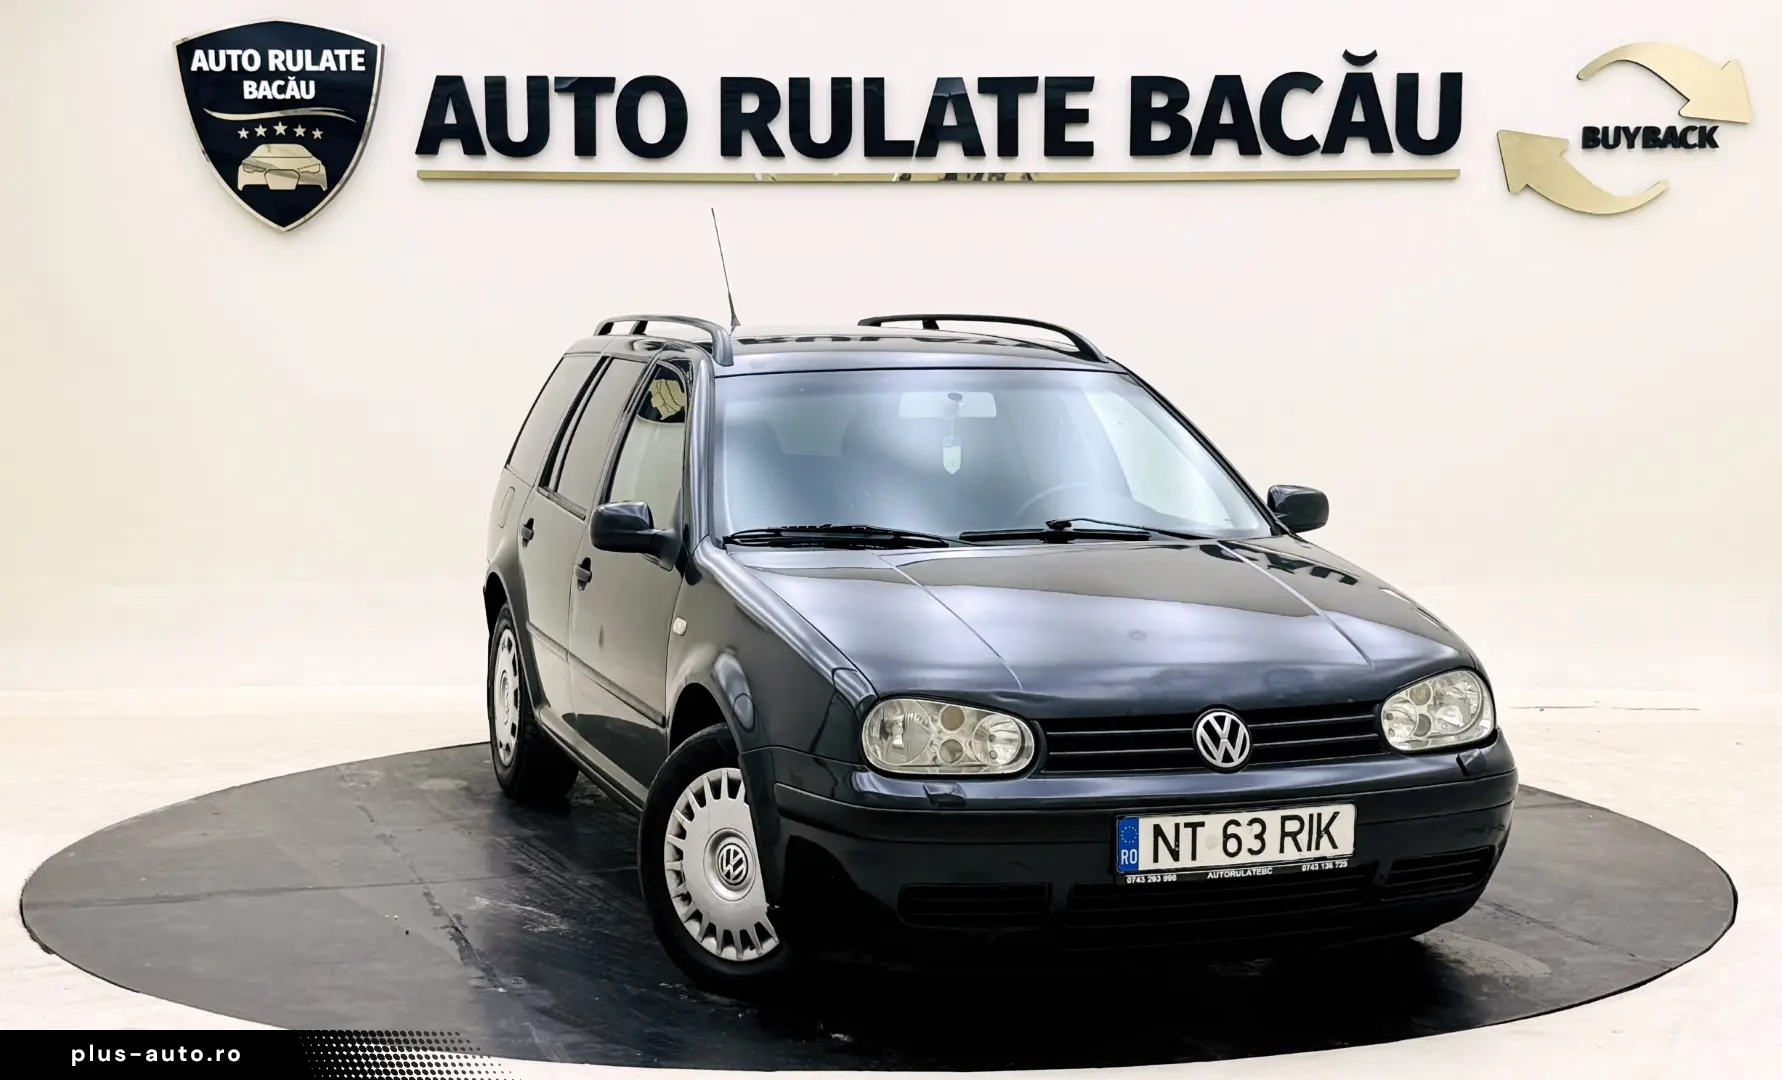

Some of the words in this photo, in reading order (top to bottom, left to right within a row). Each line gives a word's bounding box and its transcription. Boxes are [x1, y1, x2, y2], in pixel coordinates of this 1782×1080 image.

[190, 48, 262, 72] AUTO
[267, 48, 366, 72] RULATE
[242, 76, 316, 100] BACĂU
[415, 75, 688, 159] AUTO
[720, 76, 1095, 159] RULATE
[1129, 49, 1463, 157] BACĂU
[1581, 125, 1719, 150] BUYBACK
[1152, 821, 1205, 864] NT
[1222, 817, 1267, 858] 63
[1279, 811, 1341, 854] RIK
[1120, 849, 1138, 865] RO
[1302, 863, 1319, 872] 0743
[1127, 875, 1146, 884] 0743
